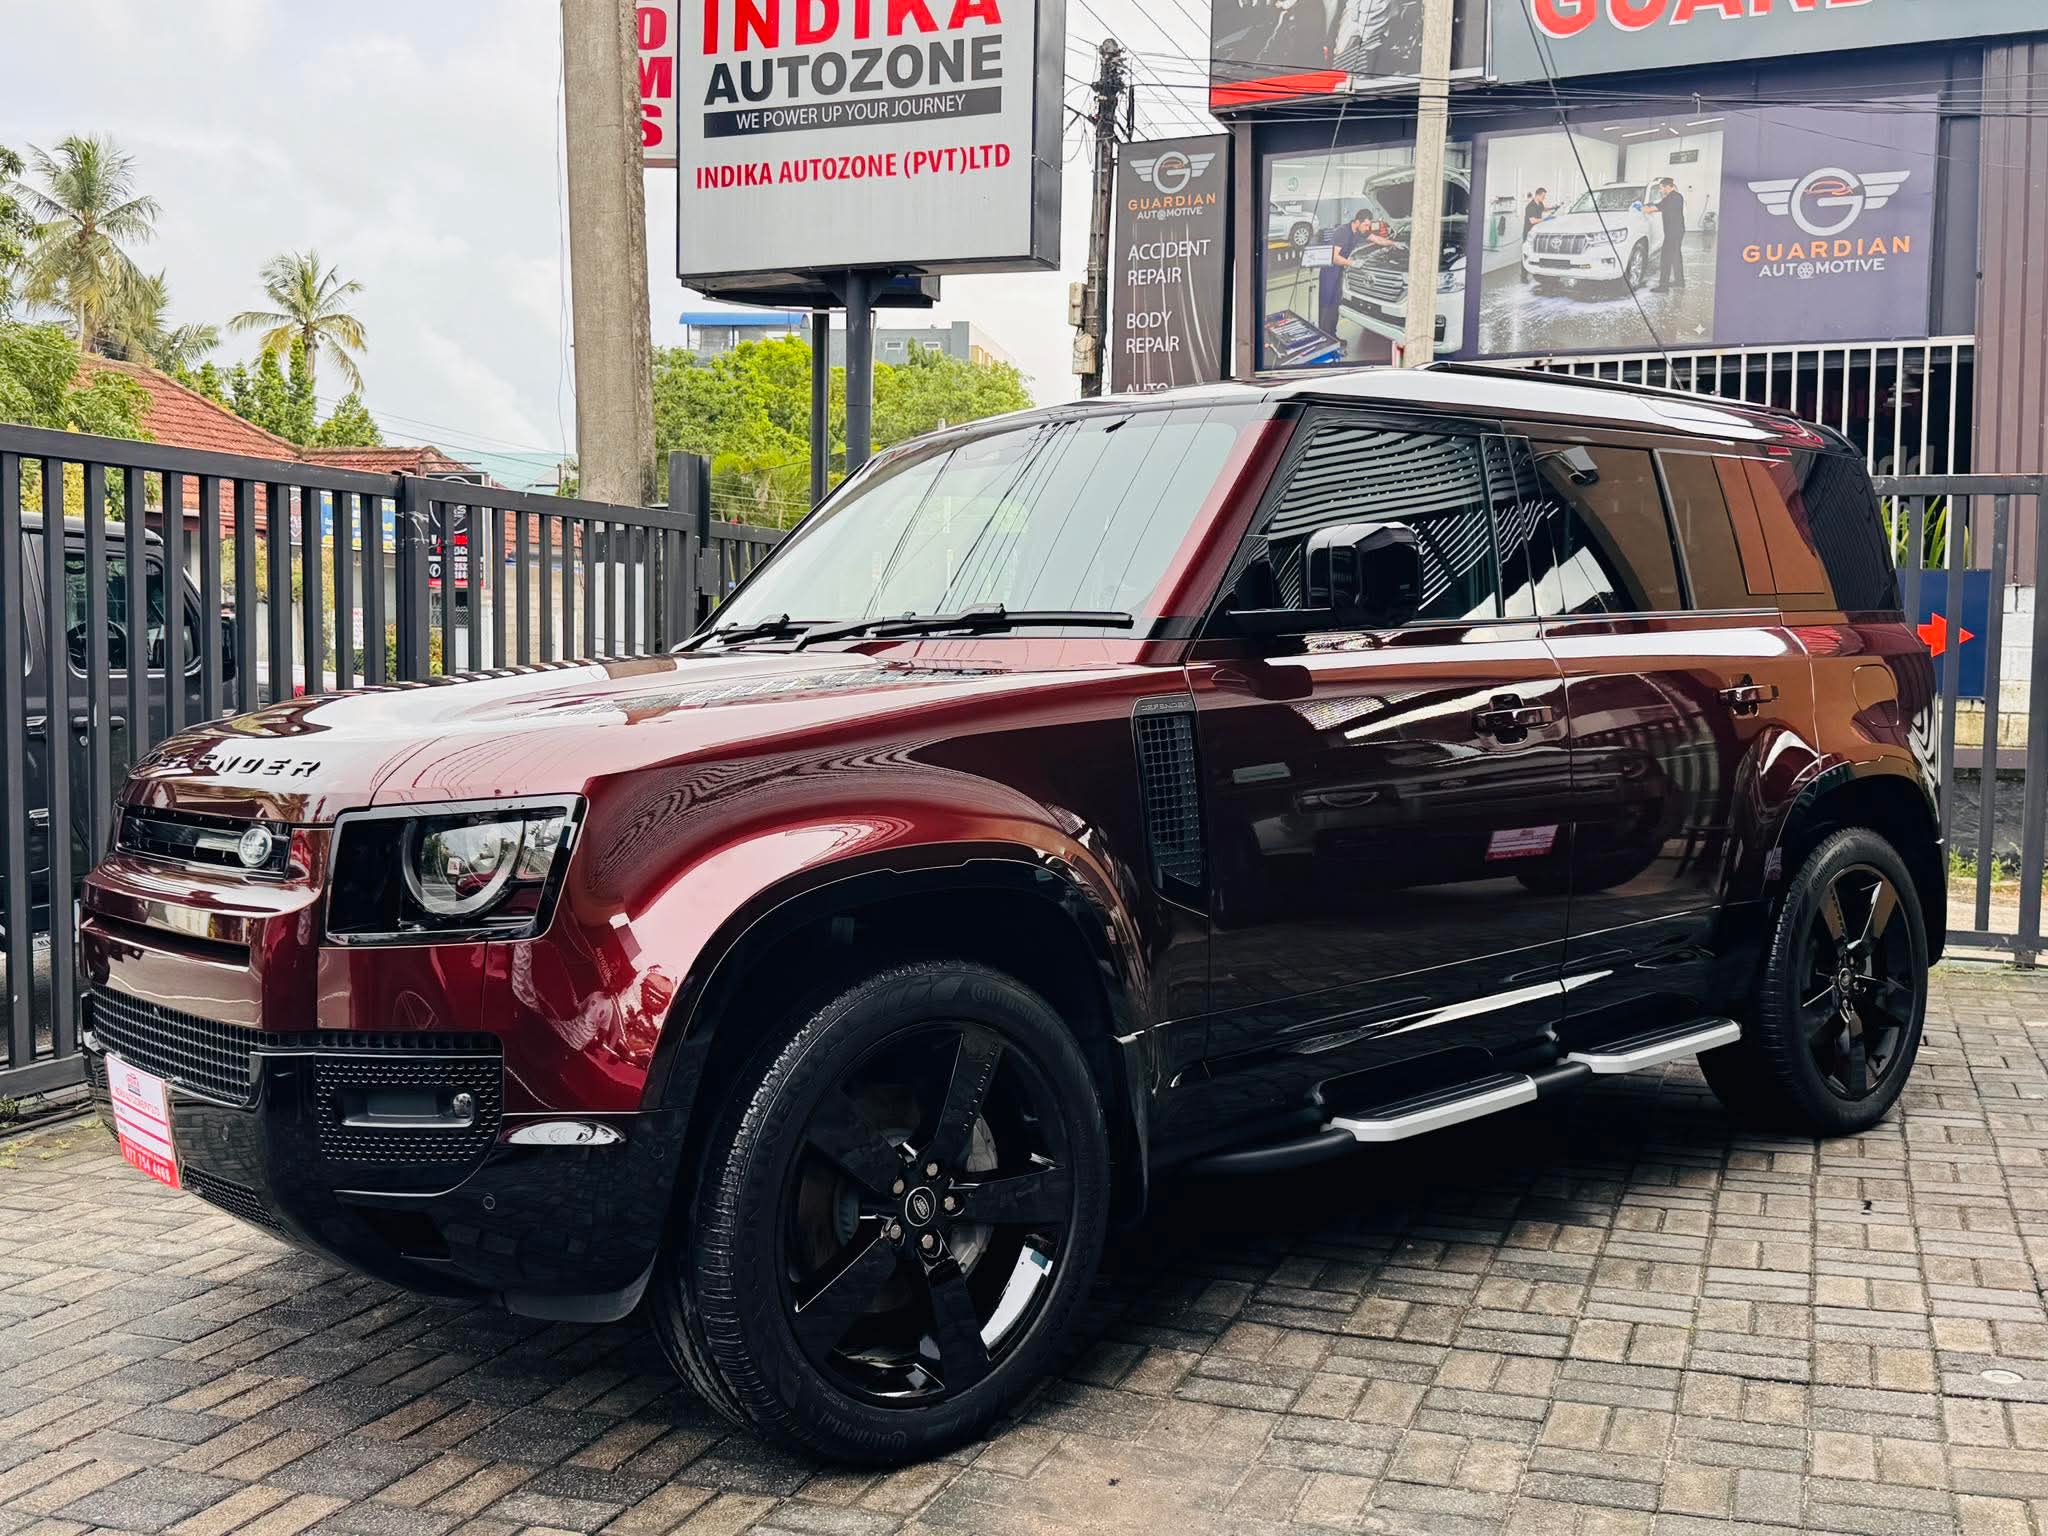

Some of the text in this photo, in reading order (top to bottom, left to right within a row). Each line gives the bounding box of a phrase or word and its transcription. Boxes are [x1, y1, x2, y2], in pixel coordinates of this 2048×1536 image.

[703, 34, 1003, 106] AUTOZONE
[736, 93, 967, 130] WE POWER UP YOUR JOURNEY
[696, 143, 1011, 190] INDIKA AUTOZONE (PVT)LTD
[1127, 191, 1217, 211] GUARDIAN
[1127, 238, 1212, 262] ACCIDENT
[1742, 234, 1911, 264] GUARDIAN
[1127, 266, 1182, 287] REPAIR
[1126, 310, 1173, 330] BODY
[1125, 335, 1180, 355] REPAIR
